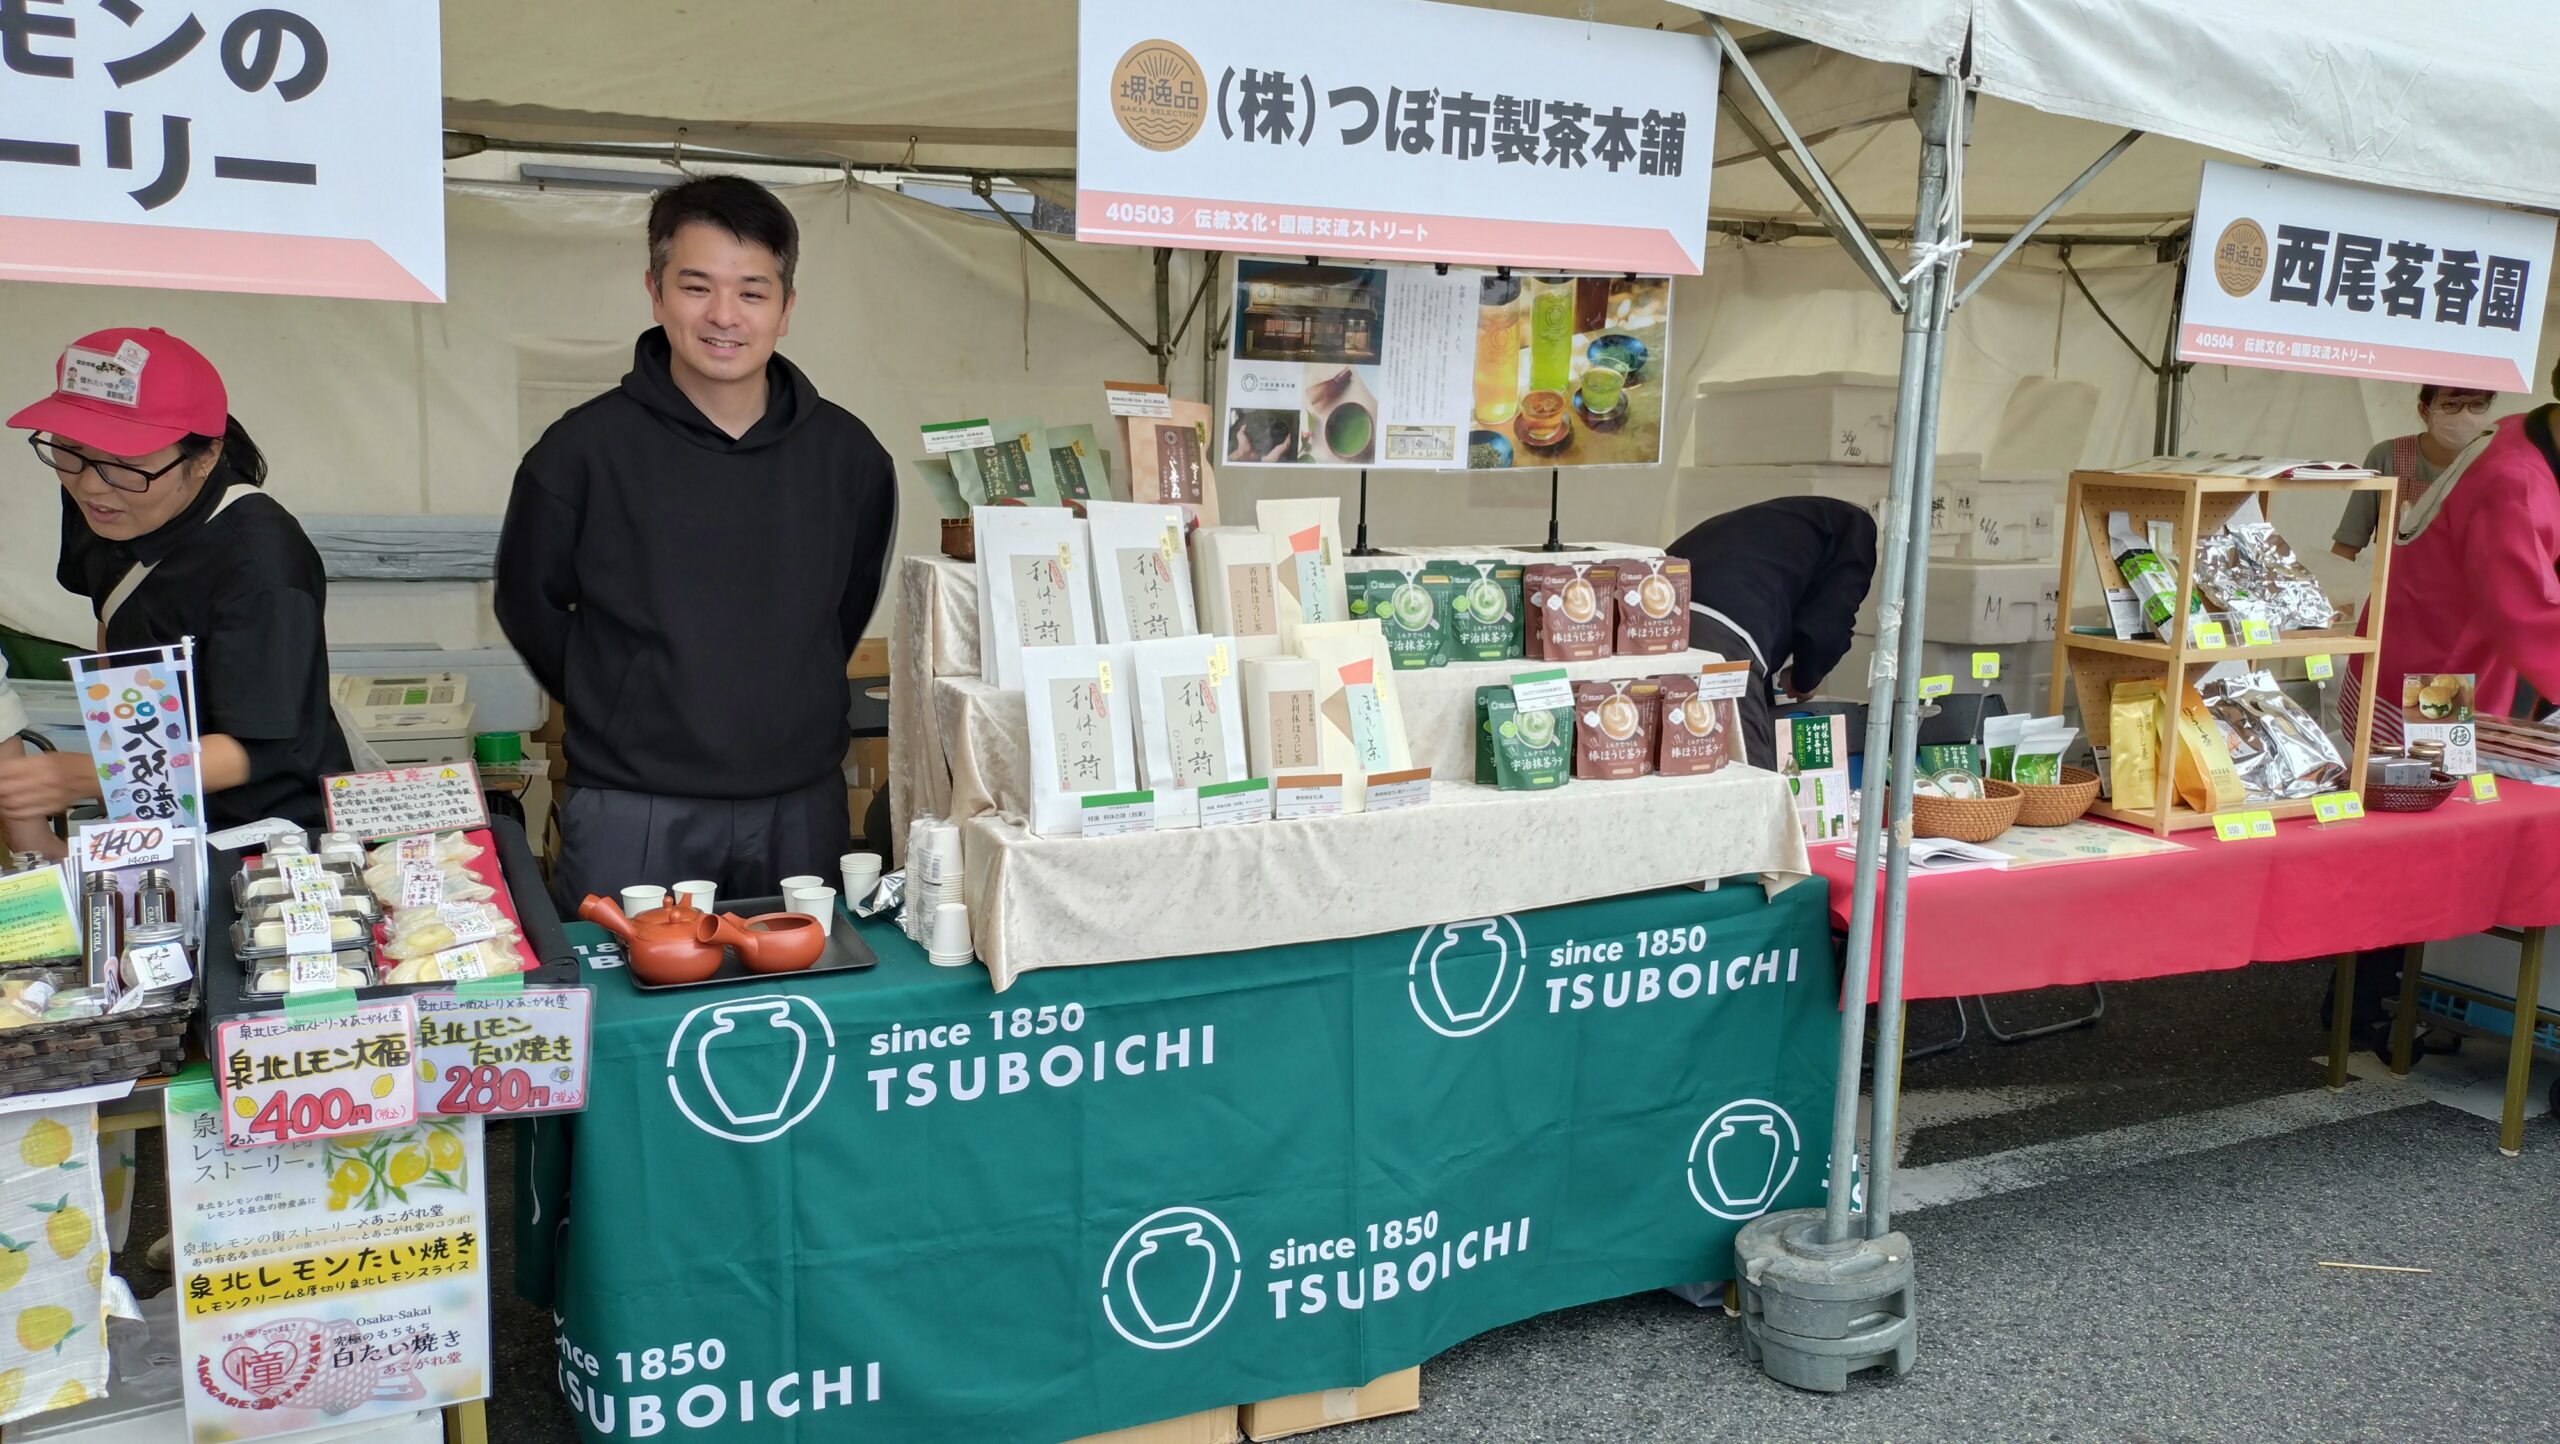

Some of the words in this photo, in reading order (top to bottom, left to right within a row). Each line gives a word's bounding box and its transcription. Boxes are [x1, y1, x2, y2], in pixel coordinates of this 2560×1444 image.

[1120, 75, 1199, 109] 堺逸品
[1120, 104, 1147, 114] SAKAI
[1150, 108, 1199, 119] SELECTION
[1106, 202, 1175, 225] 40503
[1194, 208, 1429, 242] 伝統文化・国際交流ストリート
[2269, 223, 2531, 332] 西尾茗香園
[2195, 331, 2234, 350] 40504
[1027, 560, 1061, 644] 利休の詩
[1133, 553, 1169, 637] 利休の詩
[1984, 595, 2002, 621] M
[1459, 631, 1514, 645] 宇治抹茶ラテ
[1552, 630, 1606, 644] 棒ほうじ茶ラテ
[1626, 625, 1682, 639] 棒ほうじ茶ラテ
[1066, 684, 1102, 780] 利休の詩
[1178, 682, 1214, 776] 利休の詩
[1510, 757, 1564, 772] 宇治抹茶ラテ
[1588, 748, 1648, 762] 棒ほうじ茶ラテ
[93, 906, 102, 930] CRAFT
[93, 931, 102, 953] COLA
[1549, 938, 1624, 968] since
[1636, 925, 1707, 959] 1850
[1545, 948, 1799, 1014] TSUBOICHI
[420, 1016, 532, 1048] 泉北レモン
[870, 1020, 972, 1056] since
[988, 1002, 1085, 1040] 1850
[226, 1033, 410, 1090] 泉北レモン大福
[468, 1035, 573, 1066] たい焼き
[867, 1024, 1215, 1112] TSUBOICHI
[437, 1065, 550, 1113] 280円
[192, 1112, 224, 1139] 泉
[250, 1087, 373, 1140] 400円
[196, 1192, 282, 1212] 泉北をレモンの街に
[207, 1197, 317, 1220] レモンを泉北の特産品に
[1269, 1236, 1356, 1270] since
[1366, 1210, 1439, 1252] 1850
[189, 1231, 476, 1299] 泉北レモンたい焼き
[192, 1250, 249, 1268] あの有名な
[1268, 1217, 1530, 1320] TSUBOICHI
[333, 1321, 431, 1348] 究極のもちもち
[356, 1305, 432, 1328] Osaka-Sakai
[333, 1330, 462, 1369] 白たい焼き
[383, 1351, 462, 1376] あこがれ堂
[615, 1338, 726, 1383] 1850
[196, 1355, 250, 1409] AKOGARE
[236, 1351, 287, 1391] 憧
